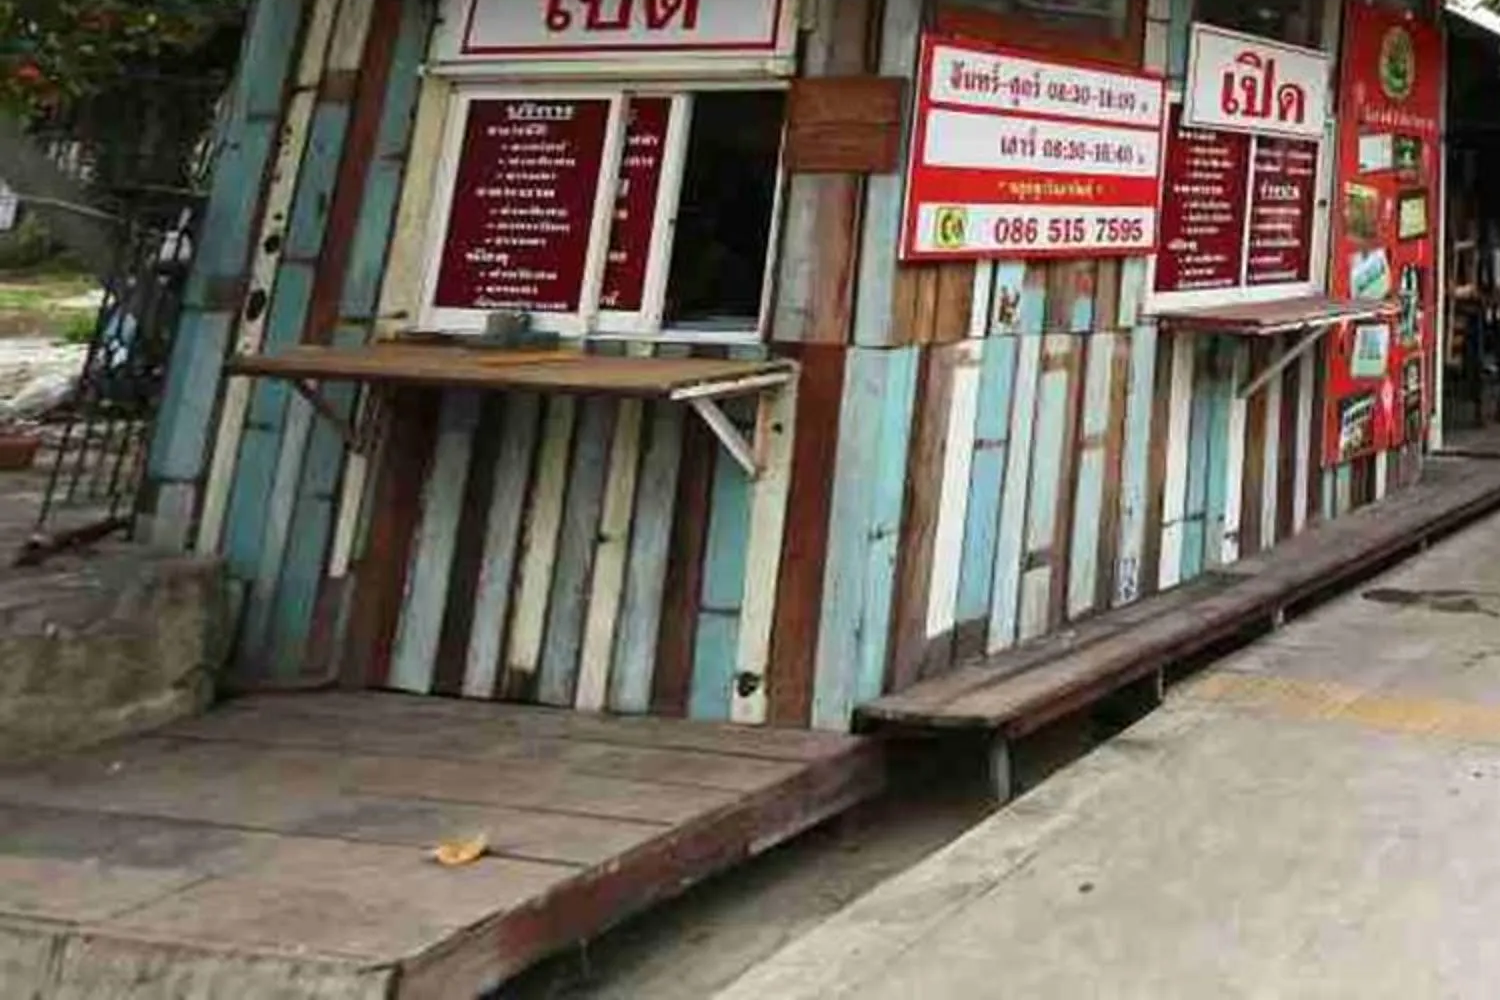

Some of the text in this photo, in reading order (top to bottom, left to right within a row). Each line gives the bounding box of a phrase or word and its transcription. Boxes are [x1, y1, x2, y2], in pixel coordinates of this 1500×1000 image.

[1220, 50, 1306, 124] เปิด
[994, 216, 1144, 244] 086 515 7595
